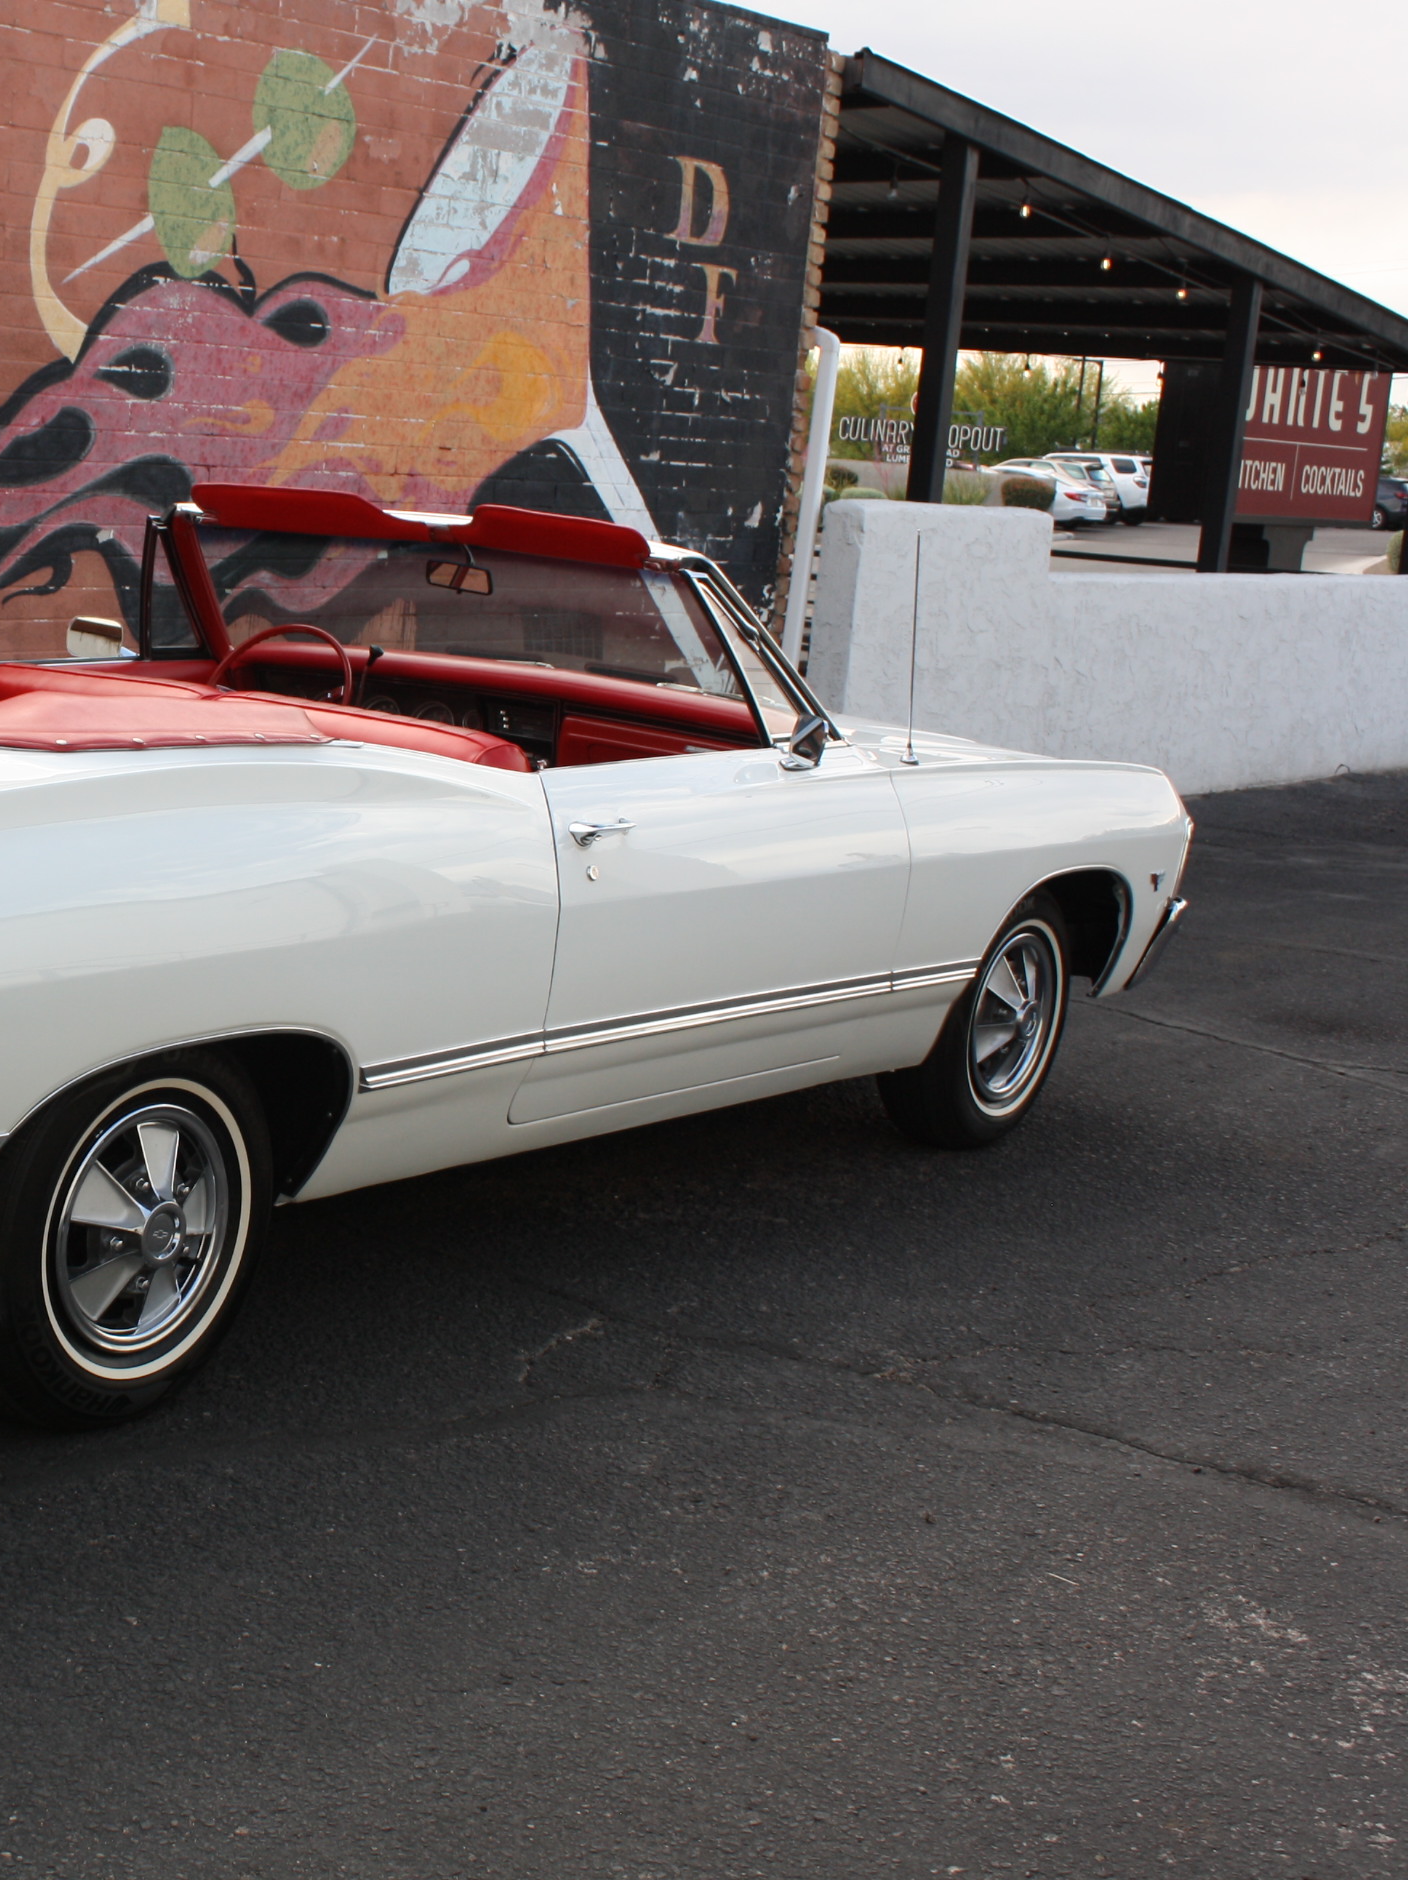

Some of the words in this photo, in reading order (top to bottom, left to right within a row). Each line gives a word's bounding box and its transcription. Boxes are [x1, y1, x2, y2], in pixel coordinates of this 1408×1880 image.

[663, 155, 730, 248] D
[691, 262, 738, 344] F
[948, 424, 1005, 452] OPOUT
[1238, 460, 1286, 492] ITCHEN
[1300, 464, 1365, 498] COCKTAILS
